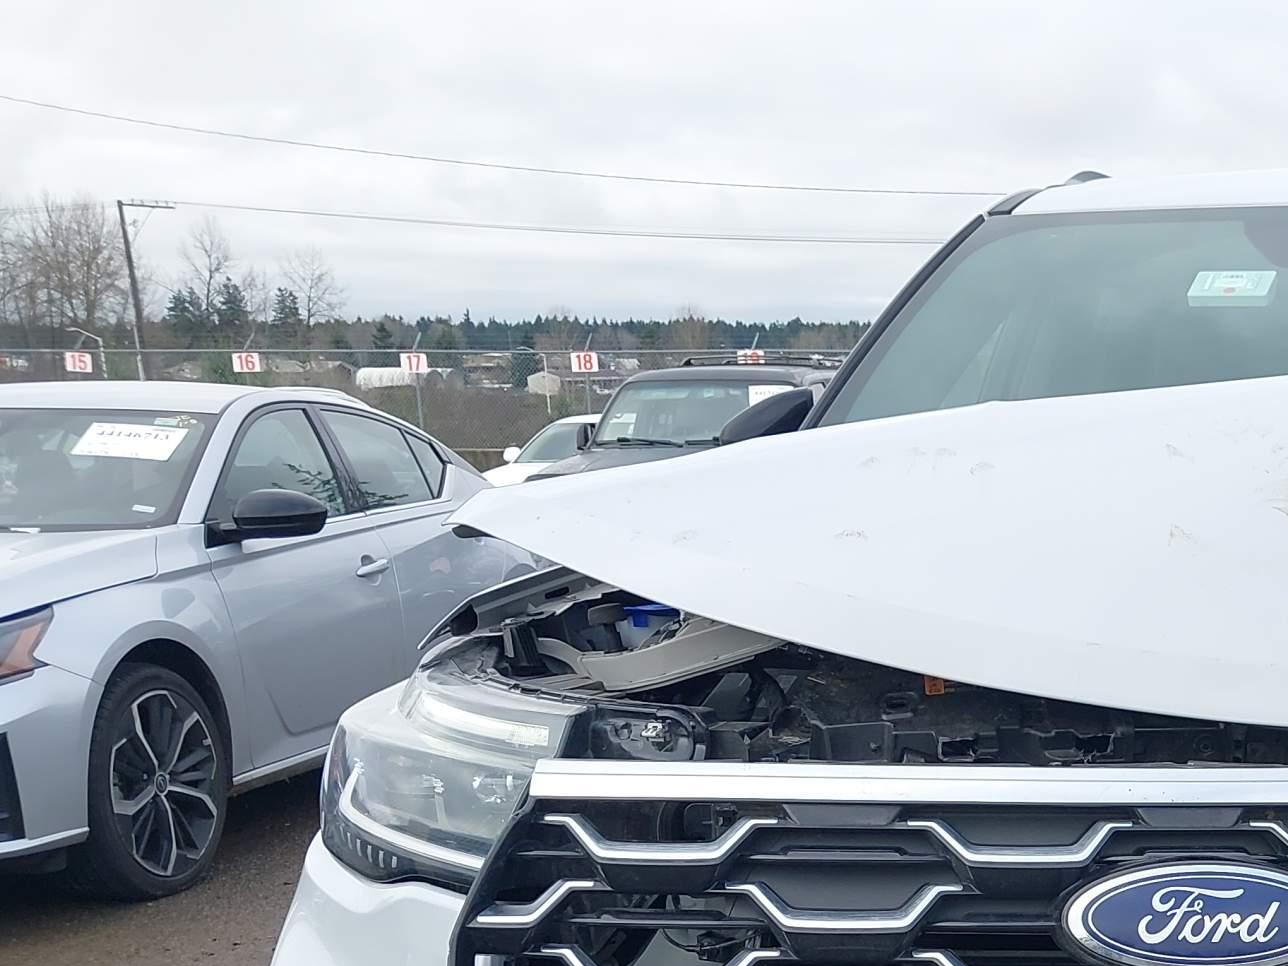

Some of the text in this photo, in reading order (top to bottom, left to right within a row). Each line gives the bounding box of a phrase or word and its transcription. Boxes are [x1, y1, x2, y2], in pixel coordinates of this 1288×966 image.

[71, 354, 88, 371] 15
[237, 354, 255, 371] 16
[406, 354, 421, 371] 17
[576, 354, 593, 370] 18
[1136, 886, 1281, 945] Ford
